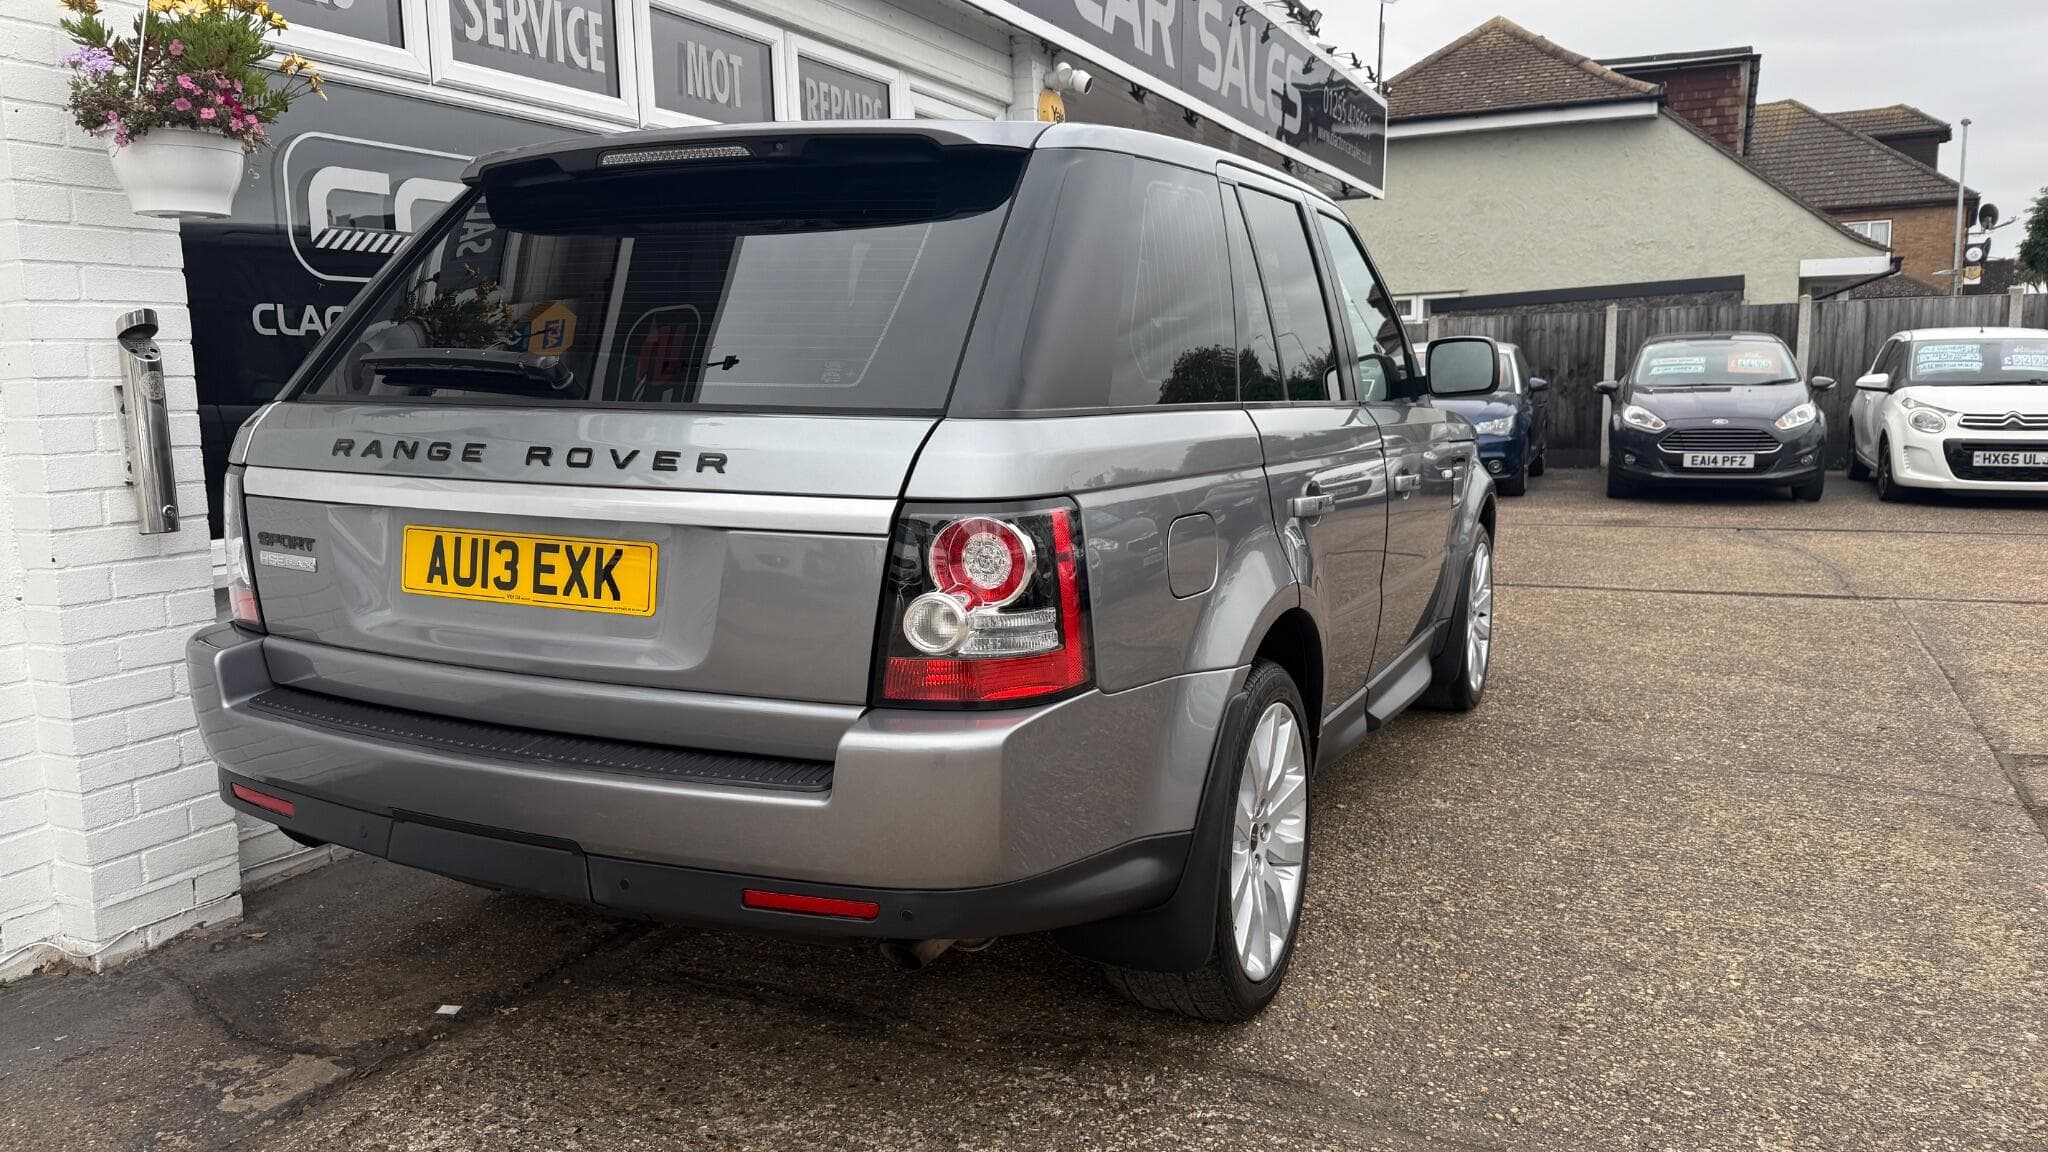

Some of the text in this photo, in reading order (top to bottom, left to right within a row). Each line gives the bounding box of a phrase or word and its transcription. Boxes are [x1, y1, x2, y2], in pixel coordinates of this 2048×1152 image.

[463, 0, 606, 73] SERVICE
[686, 39, 742, 108] MOT
[1074, 0, 1303, 135] AR SALES
[331, 438, 729, 475] RANGE ROVER
[1691, 455, 1747, 466] EA14 PFZ
[1983, 453, 2020, 465] HX65
[257, 531, 316, 552] SPORT
[426, 535, 624, 602] AU13 EXK
